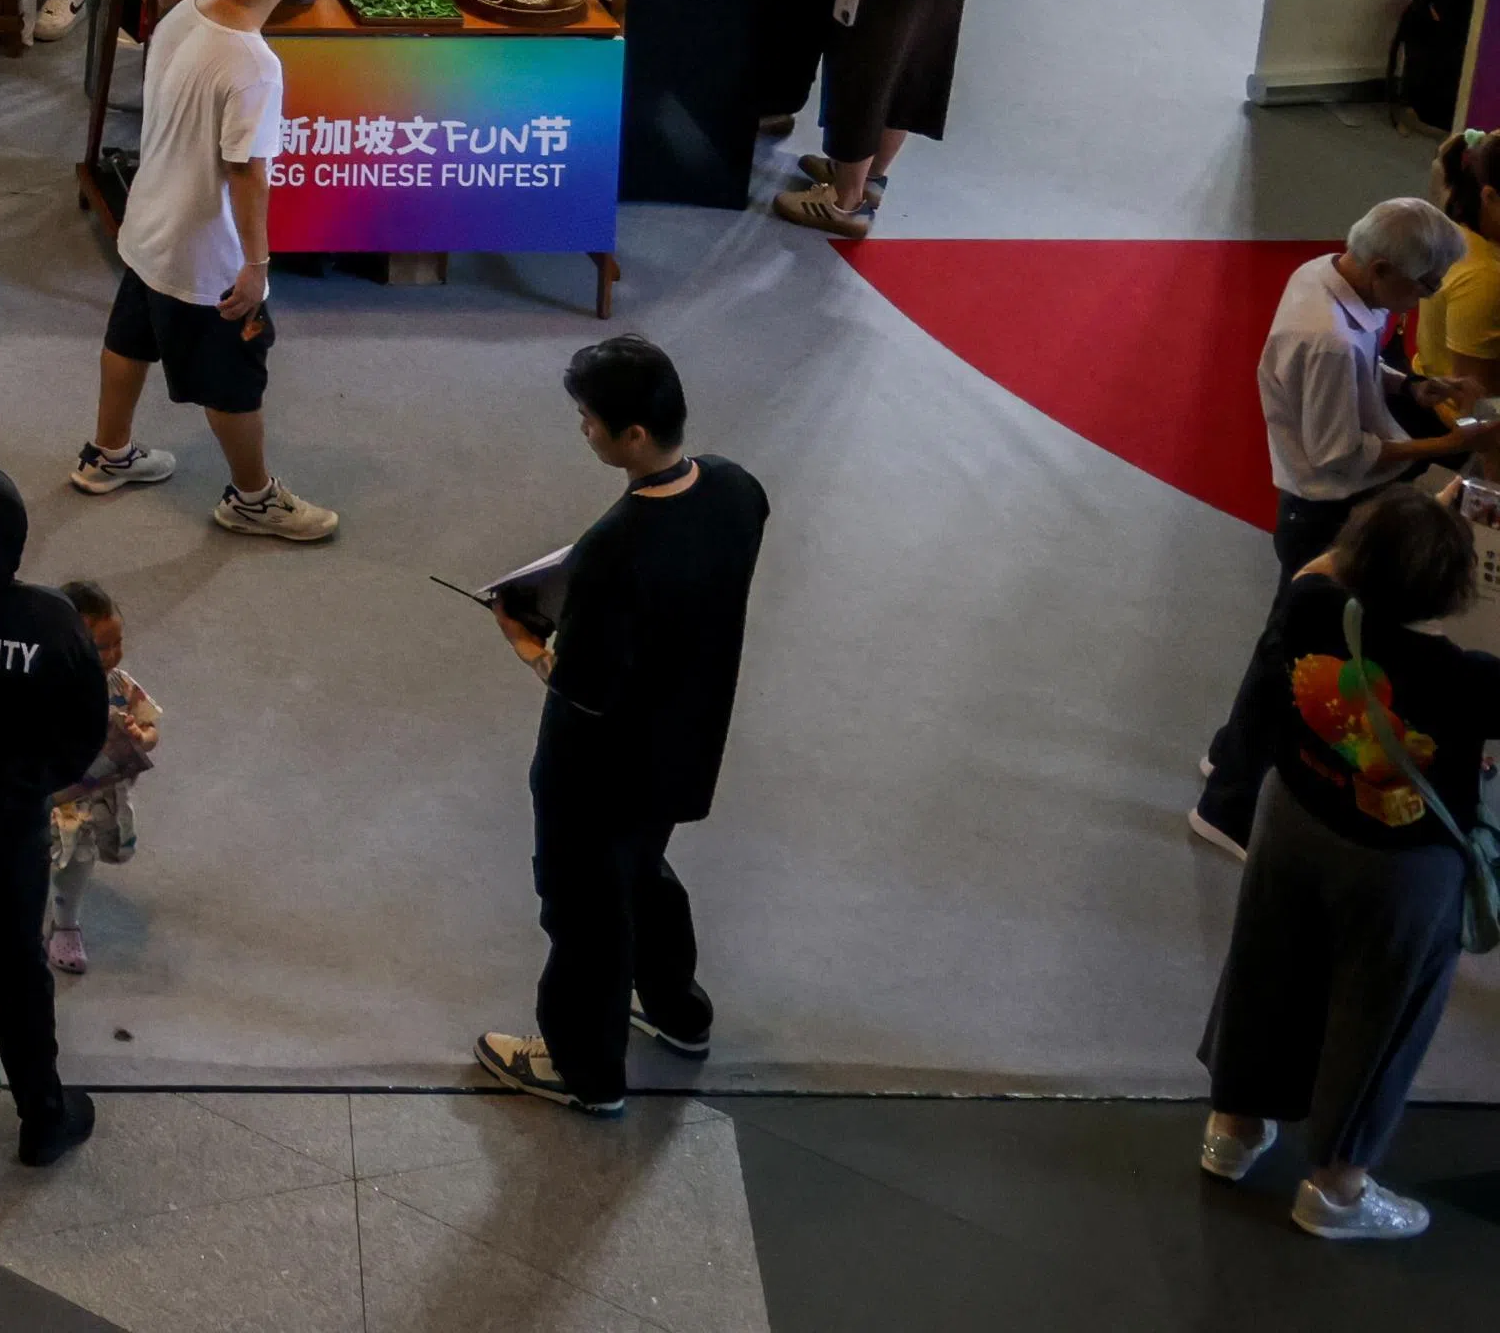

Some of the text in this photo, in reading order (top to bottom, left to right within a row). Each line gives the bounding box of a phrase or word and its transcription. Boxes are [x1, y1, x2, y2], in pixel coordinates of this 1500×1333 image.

[276, 113, 572, 159] 新加坡文FUN节
[269, 162, 566, 189] SG CHINESE FUNFEST
